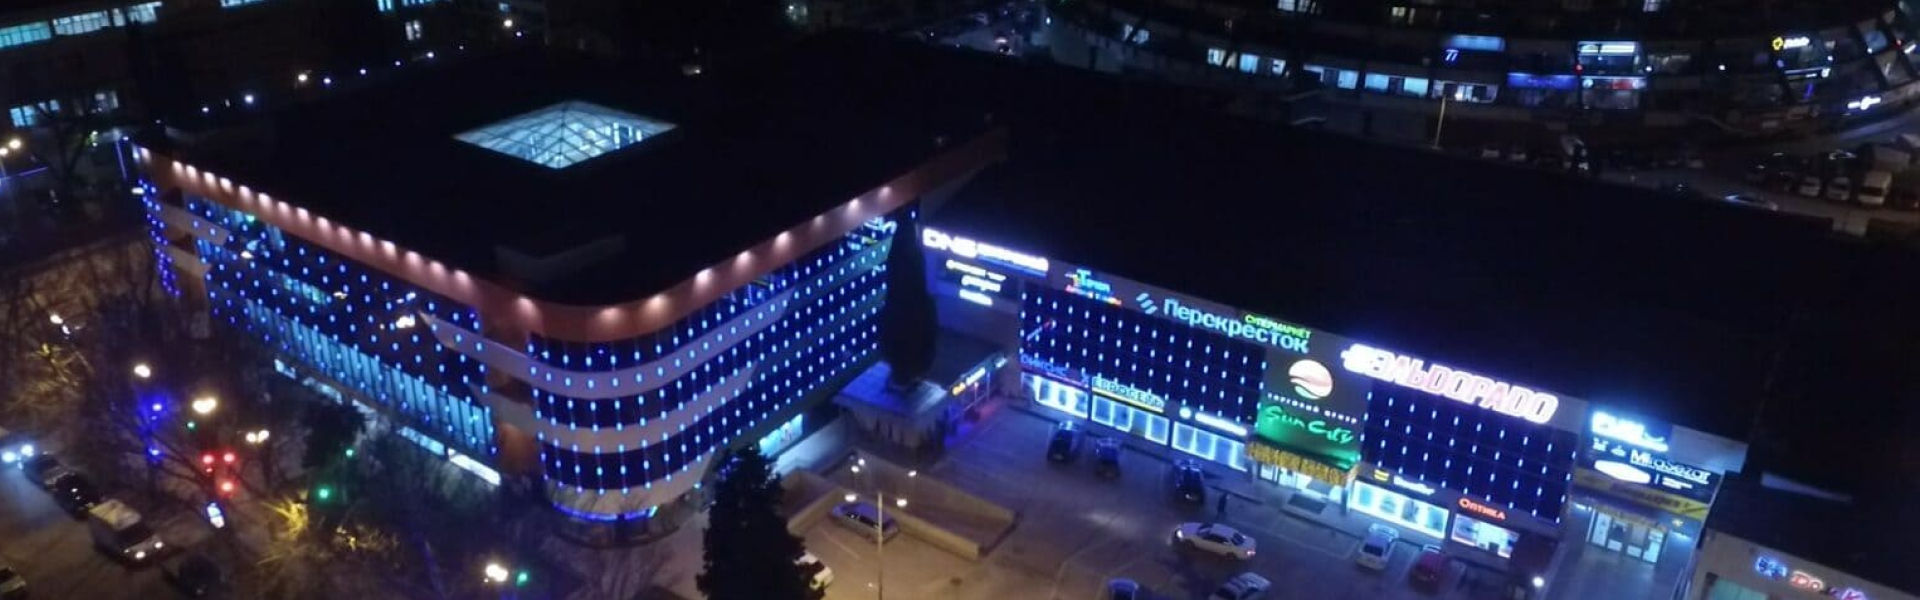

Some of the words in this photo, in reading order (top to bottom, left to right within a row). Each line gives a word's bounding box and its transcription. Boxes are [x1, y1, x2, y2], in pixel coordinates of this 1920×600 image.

[922, 228, 976, 258] DNS
[1163, 298, 1309, 354] Перекресток
[1265, 405, 1305, 428] Sun
[1307, 420, 1354, 445] City
